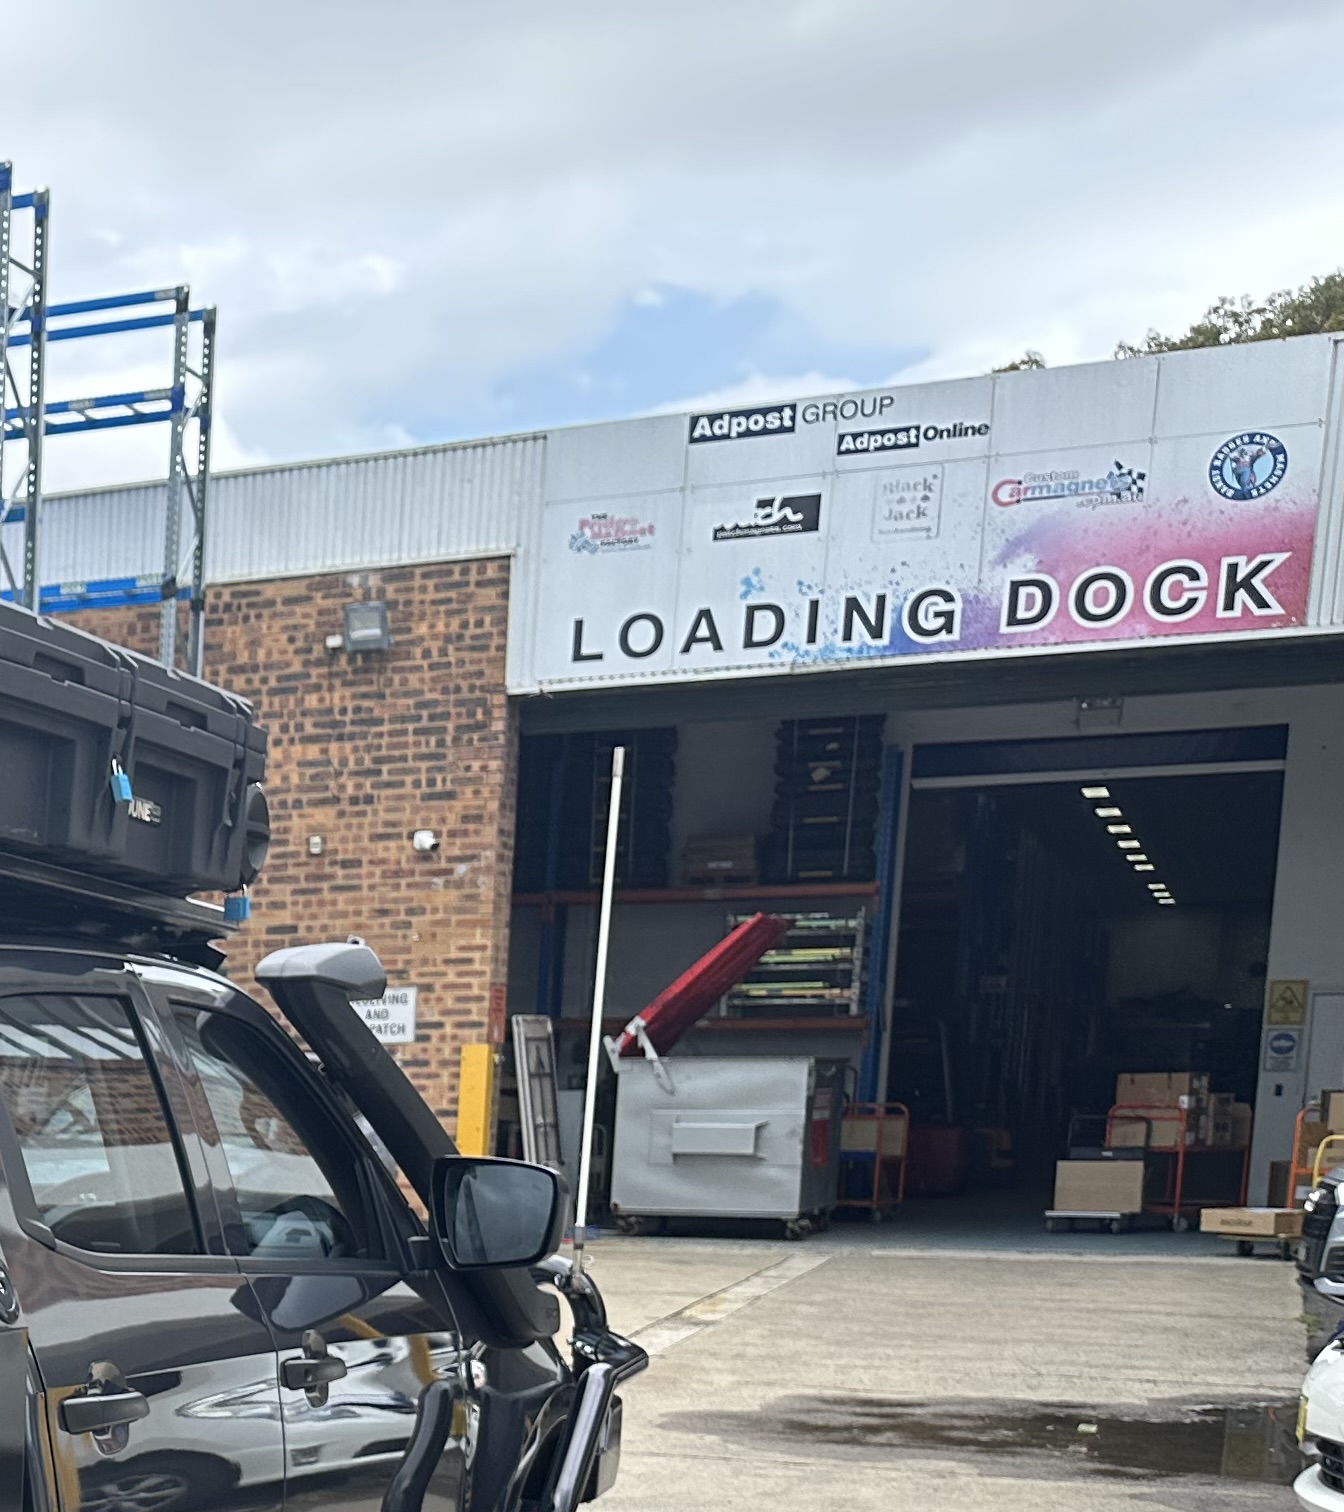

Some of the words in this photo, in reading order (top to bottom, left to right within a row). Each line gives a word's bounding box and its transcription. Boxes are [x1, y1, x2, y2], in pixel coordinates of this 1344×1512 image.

[692, 406, 794, 438] Adpost
[801, 395, 894, 425] GROUP
[839, 427, 918, 452] Adpost
[923, 421, 990, 441] Online
[572, 588, 961, 662] LOADING
[1003, 556, 1286, 632] DOCK
[365, 1008, 389, 1020] AND
